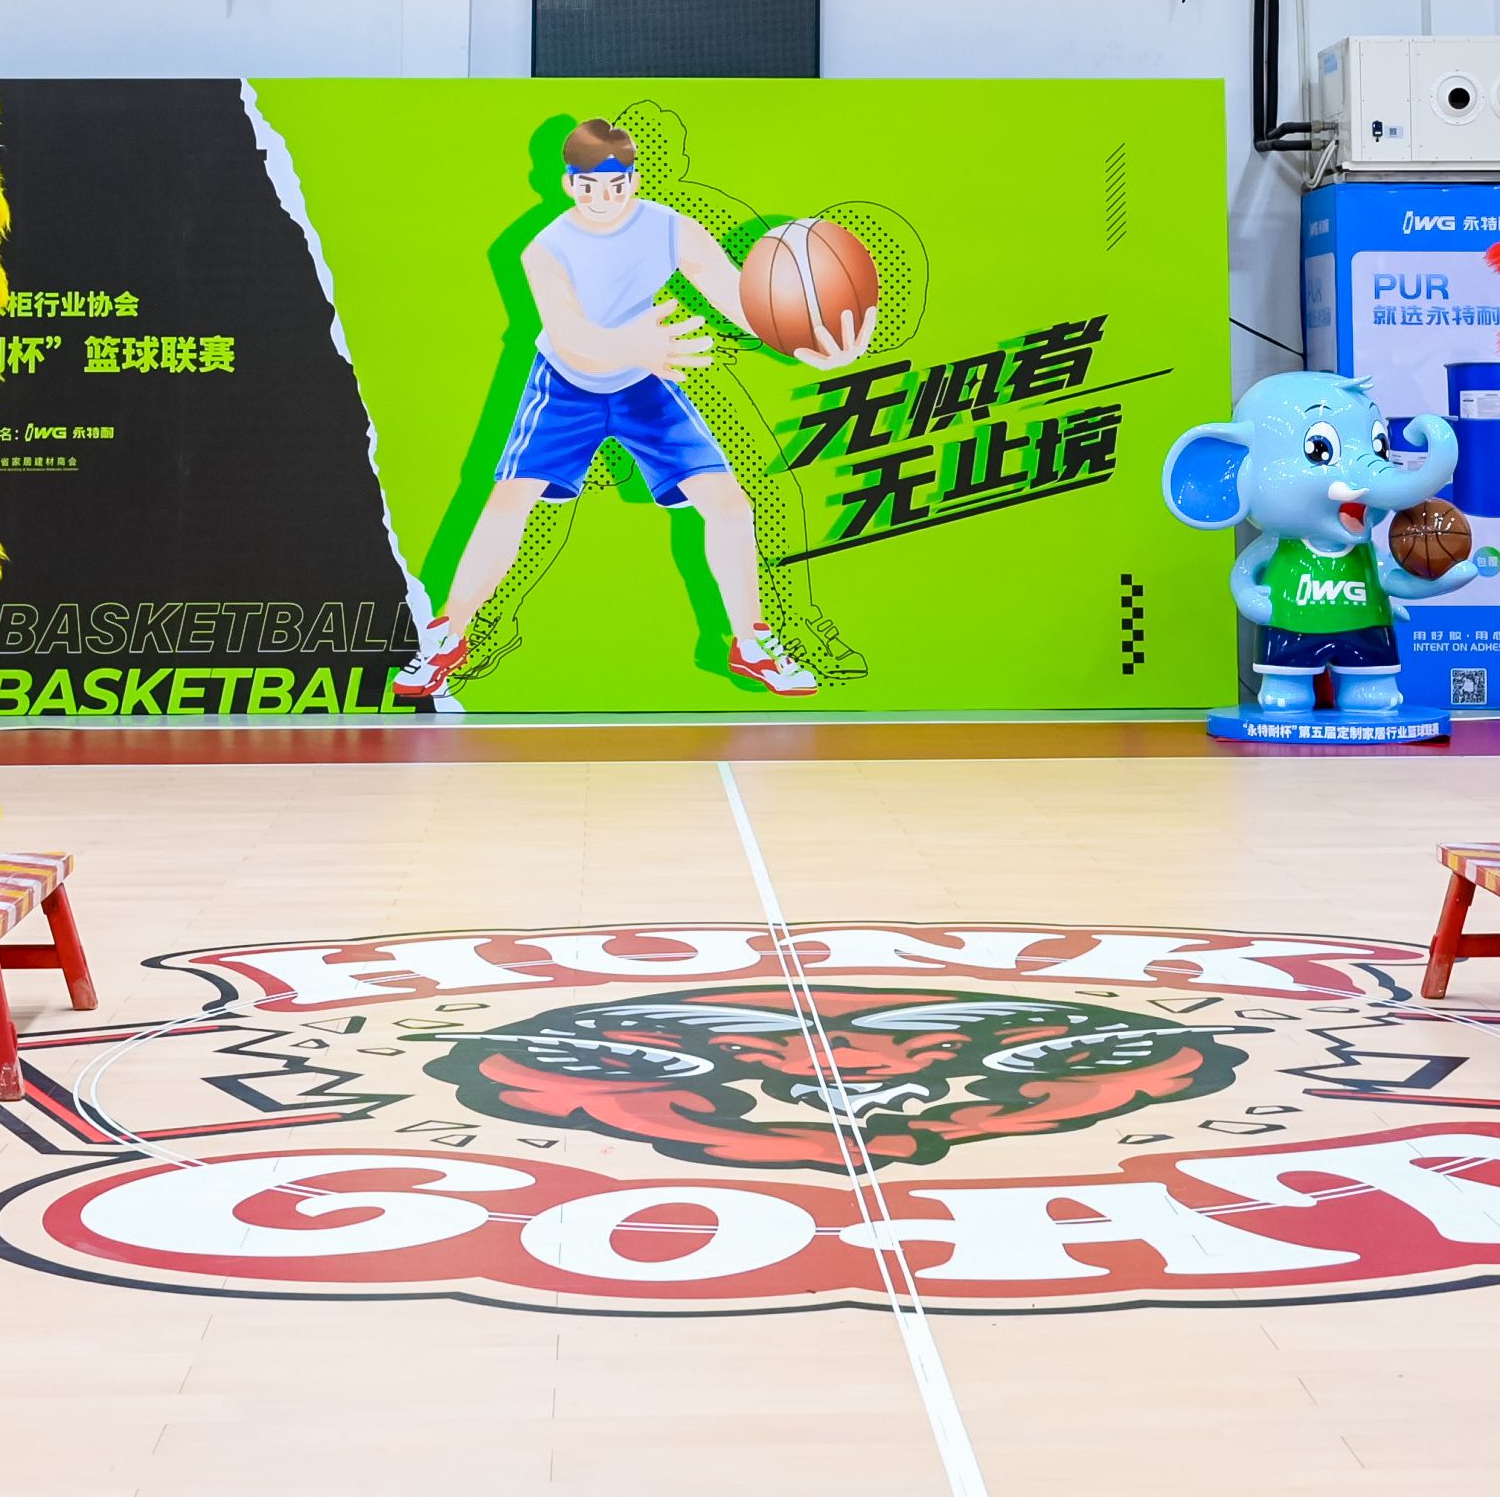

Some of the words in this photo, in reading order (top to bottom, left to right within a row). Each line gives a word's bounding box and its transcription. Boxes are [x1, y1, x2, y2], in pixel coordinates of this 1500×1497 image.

[1373, 273, 1449, 300] PUR
[1373, 306, 1500, 326] 就选永特耐
[84, 335, 236, 374] 篮球联赛
[789, 314, 1109, 471] 无惧者
[72, 426, 115, 439] 永特耐
[836, 403, 1123, 540] 无止境
[1413, 642, 1449, 652] INTENT
[1452, 642, 1468, 652] ON
[217, 928, 1374, 1005] HUNK
